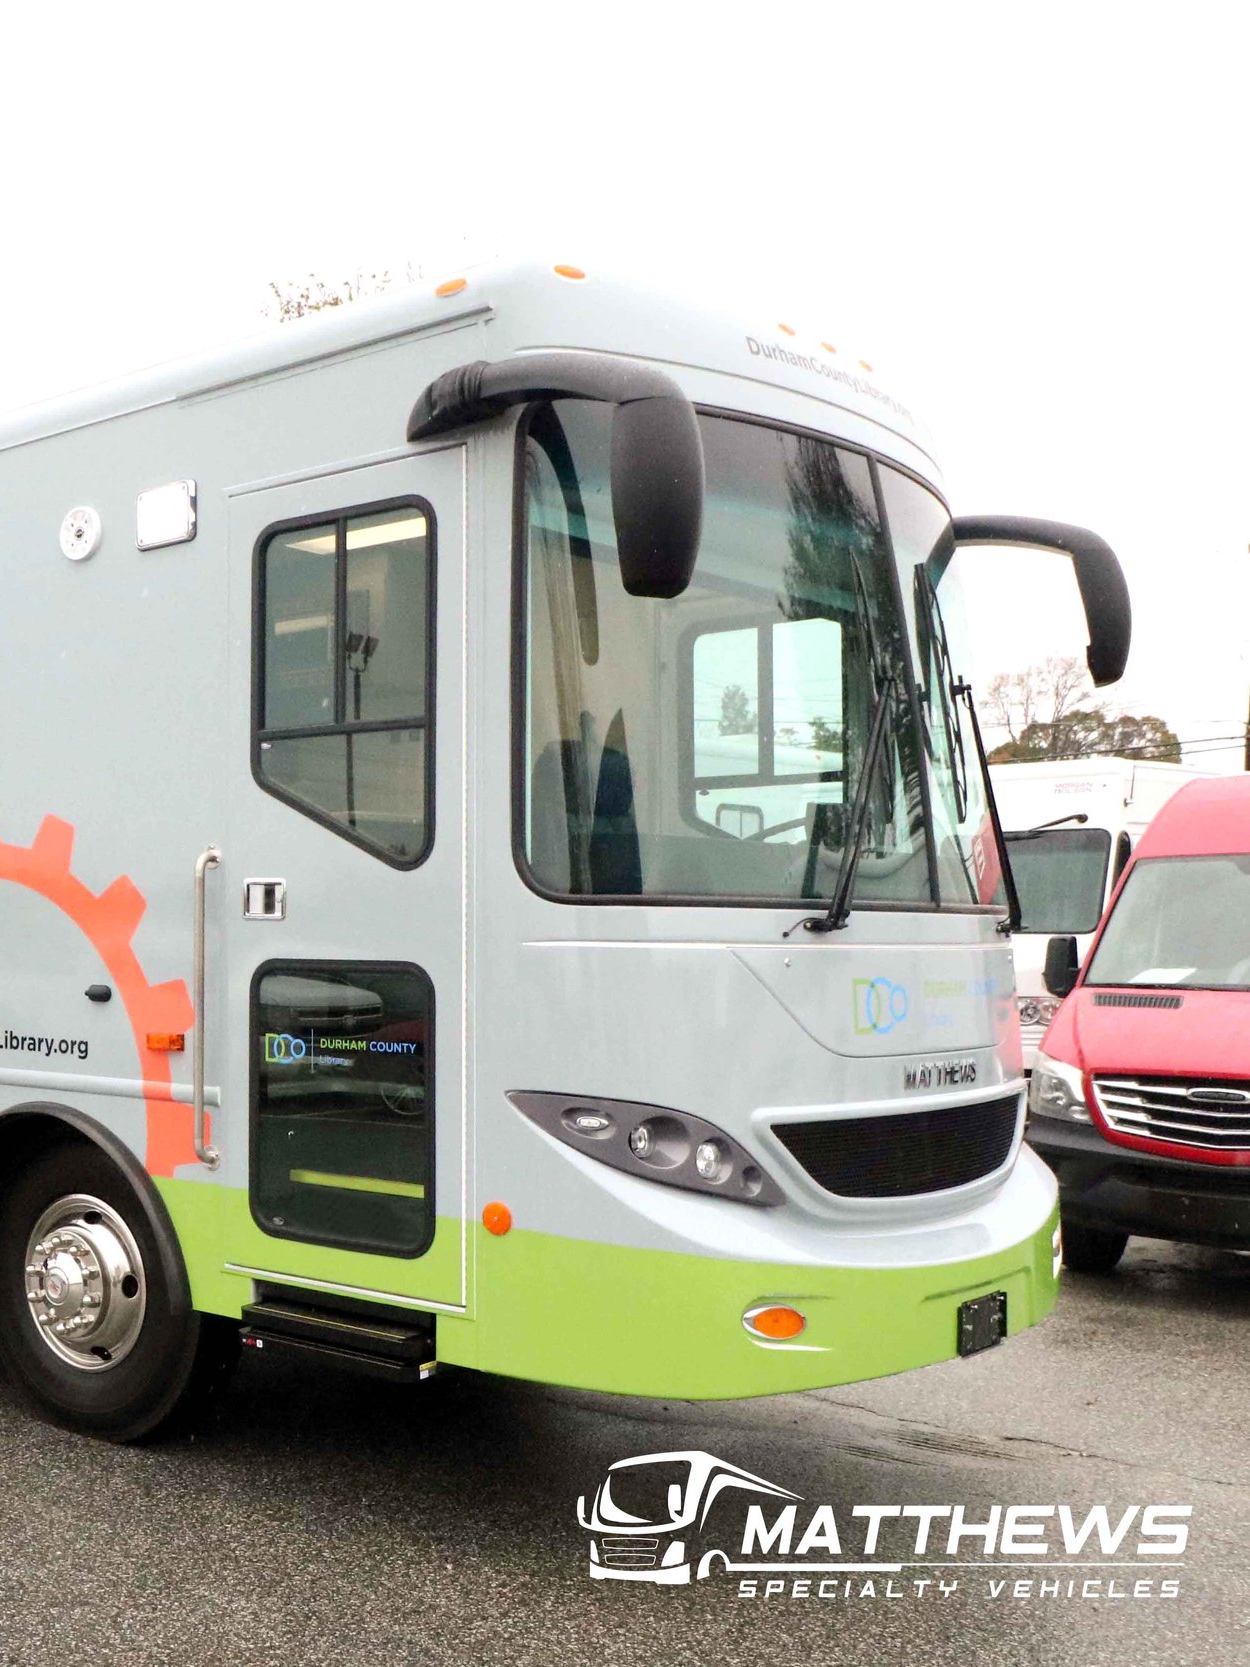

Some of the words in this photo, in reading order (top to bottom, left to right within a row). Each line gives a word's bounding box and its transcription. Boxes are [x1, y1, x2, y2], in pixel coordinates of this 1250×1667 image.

[320, 1038, 367, 1051] DURHAM
[369, 1041, 417, 1054] COUNTY
[904, 1060, 977, 1091] MATTHEWS
